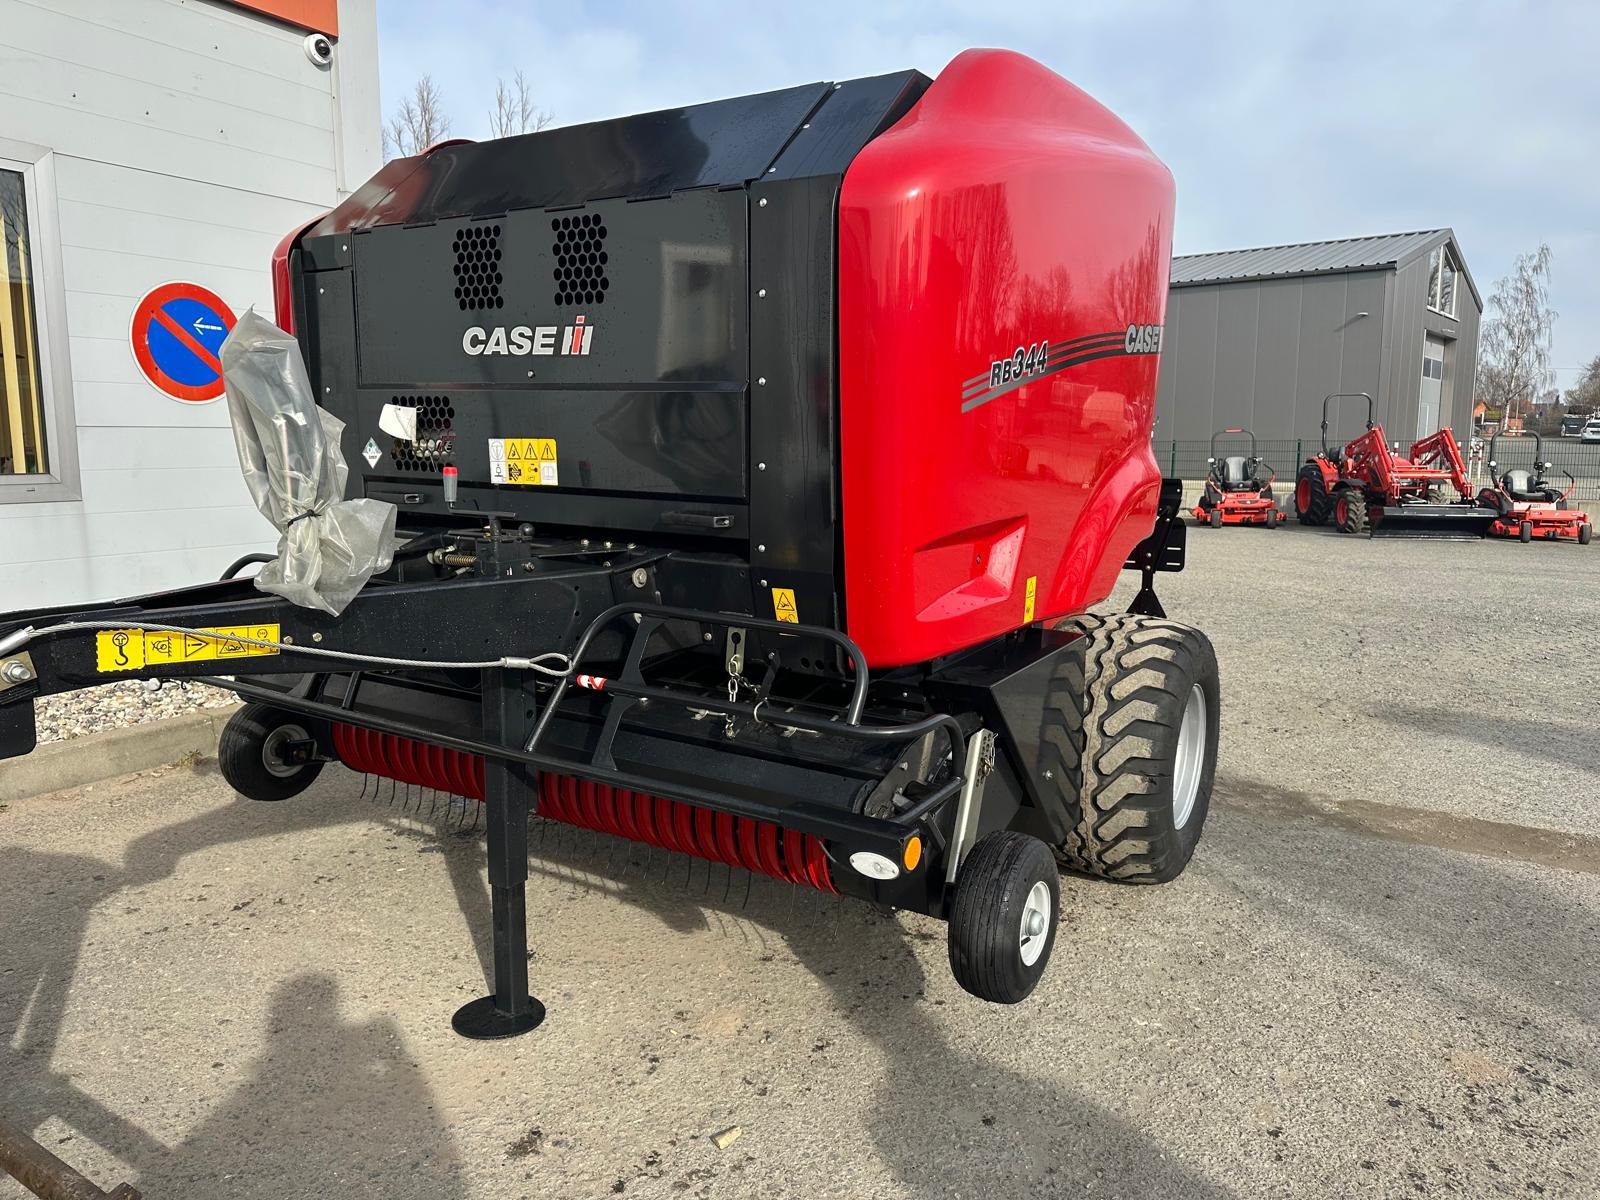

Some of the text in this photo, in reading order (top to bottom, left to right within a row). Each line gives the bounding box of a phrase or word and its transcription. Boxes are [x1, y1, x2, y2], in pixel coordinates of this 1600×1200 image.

[462, 326, 557, 355] CASE
[1125, 324, 1160, 353] CASE
[989, 340, 1048, 387] RB344
